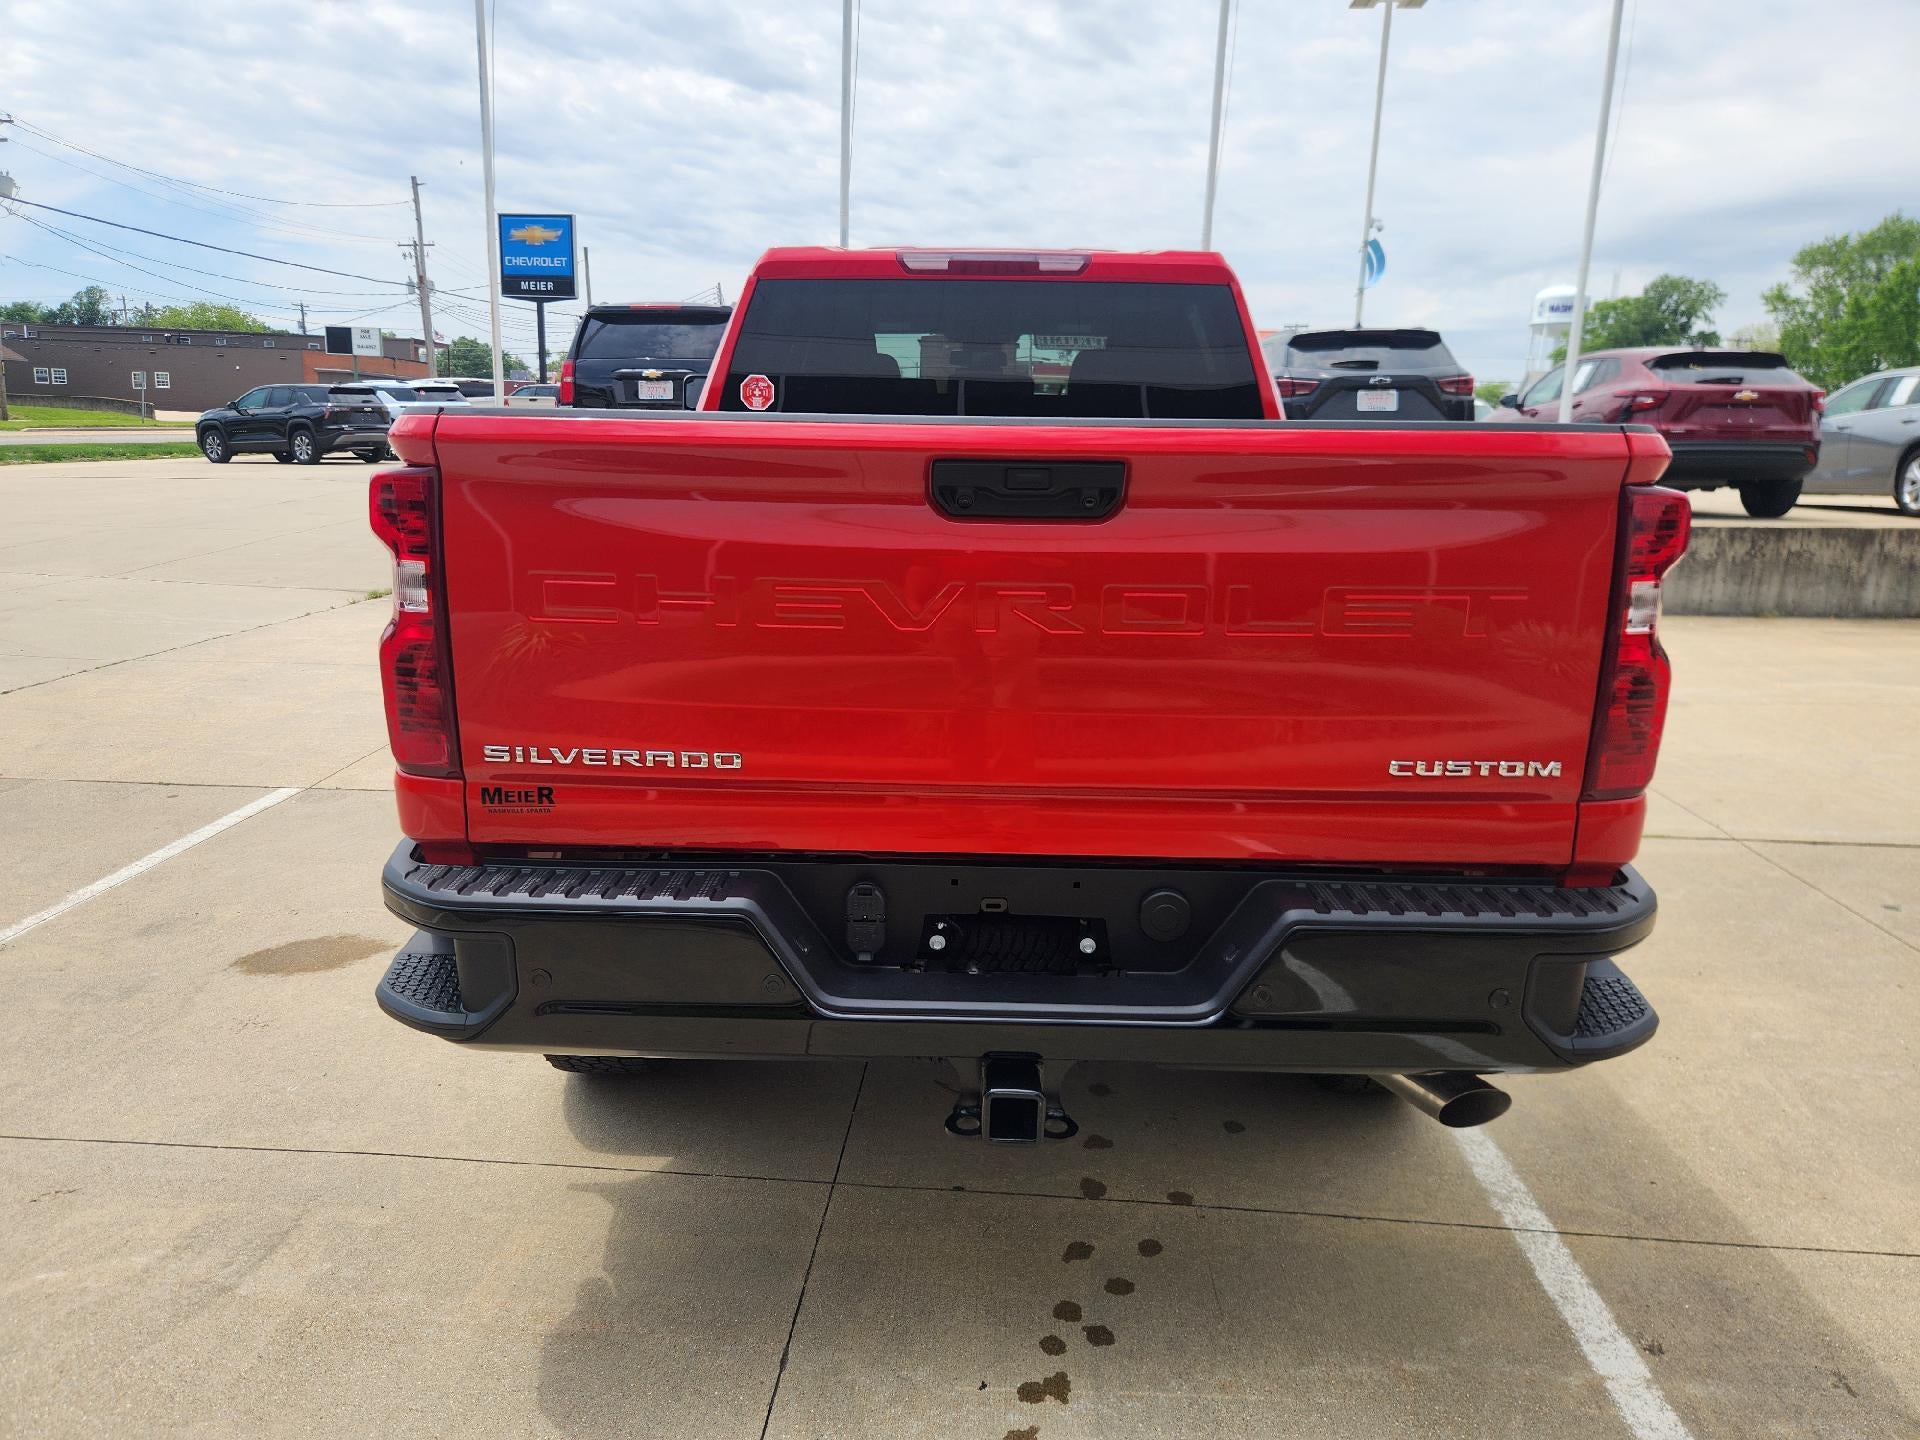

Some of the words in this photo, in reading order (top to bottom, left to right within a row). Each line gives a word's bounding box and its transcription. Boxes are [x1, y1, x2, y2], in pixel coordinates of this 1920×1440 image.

[504, 256, 567, 267] CHEVROLET
[520, 281, 554, 291] MEIER
[527, 569, 1529, 637] CHEVROLET
[483, 745, 742, 769] SILVERADO
[1388, 760, 1562, 777] CUSTOM
[481, 786, 556, 805] MEIER
